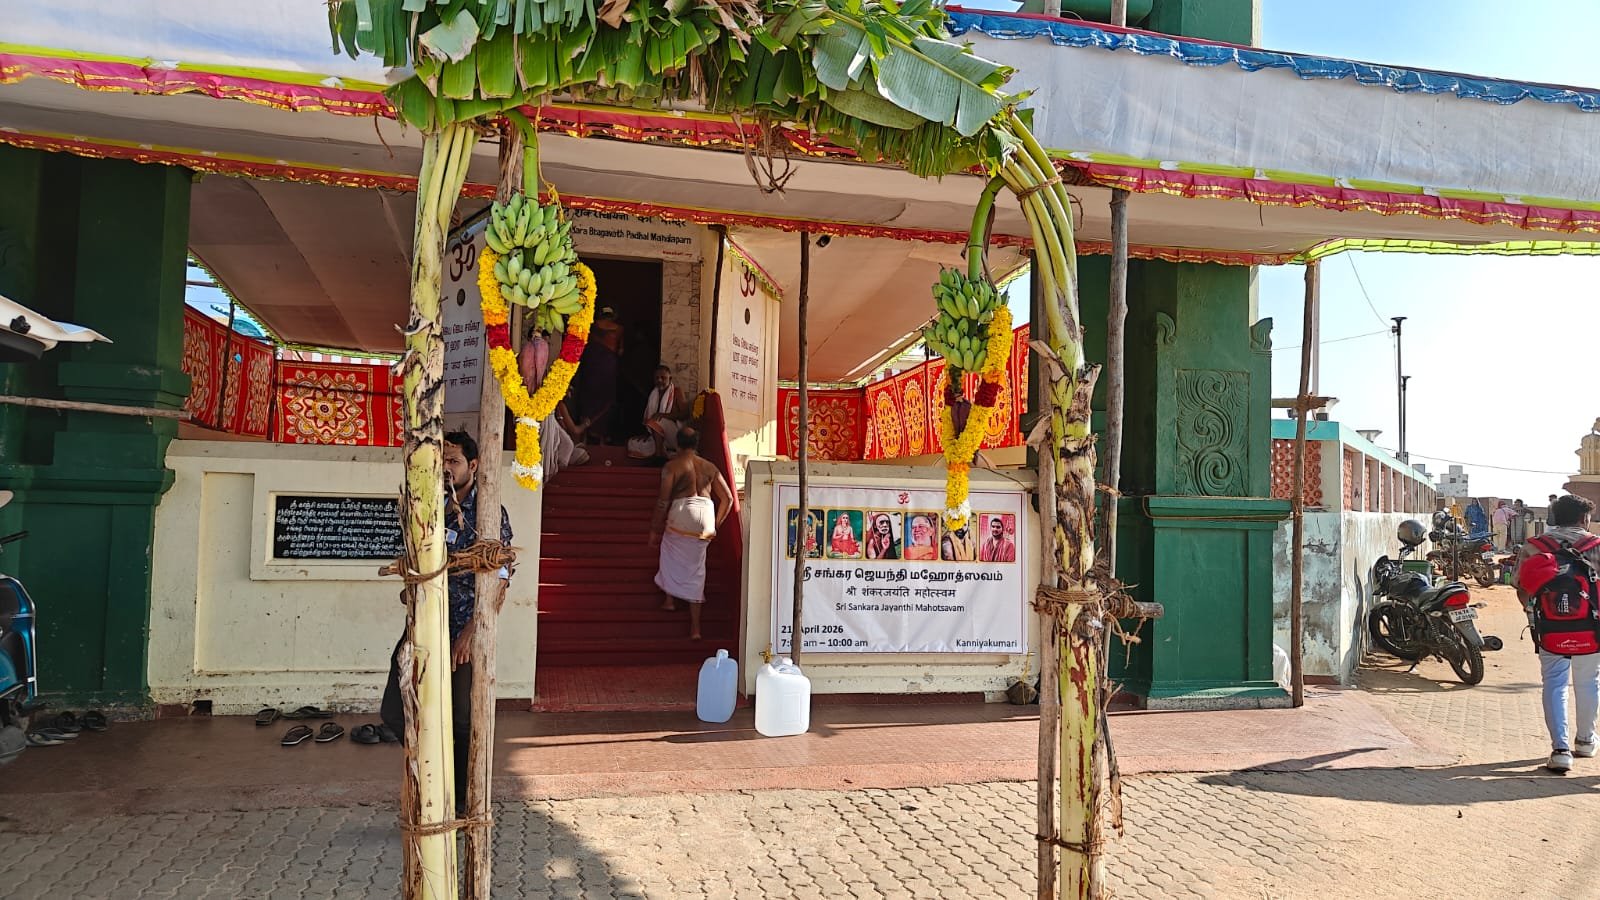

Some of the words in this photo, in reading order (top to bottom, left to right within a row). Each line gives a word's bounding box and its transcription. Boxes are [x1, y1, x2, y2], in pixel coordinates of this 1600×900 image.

[814, 567, 852, 581] சங்கர
[855, 568, 907, 582] ஜெயந்தி
[910, 569, 1003, 583] மஹோத்ஸவம்
[846, 586, 857, 597] श्री
[836, 603, 846, 611] Sri
[848, 603, 879, 611] Sankara
[881, 603, 913, 612] Jayanthi
[915, 604, 965, 612] Mahotsavam
[781, 625, 793, 634] 21
[822, 625, 844, 634] 2026
[781, 639, 793, 647] 7:
[827, 639, 852, 647] 10:00
[956, 638, 1017, 649] Kanniyakumari
